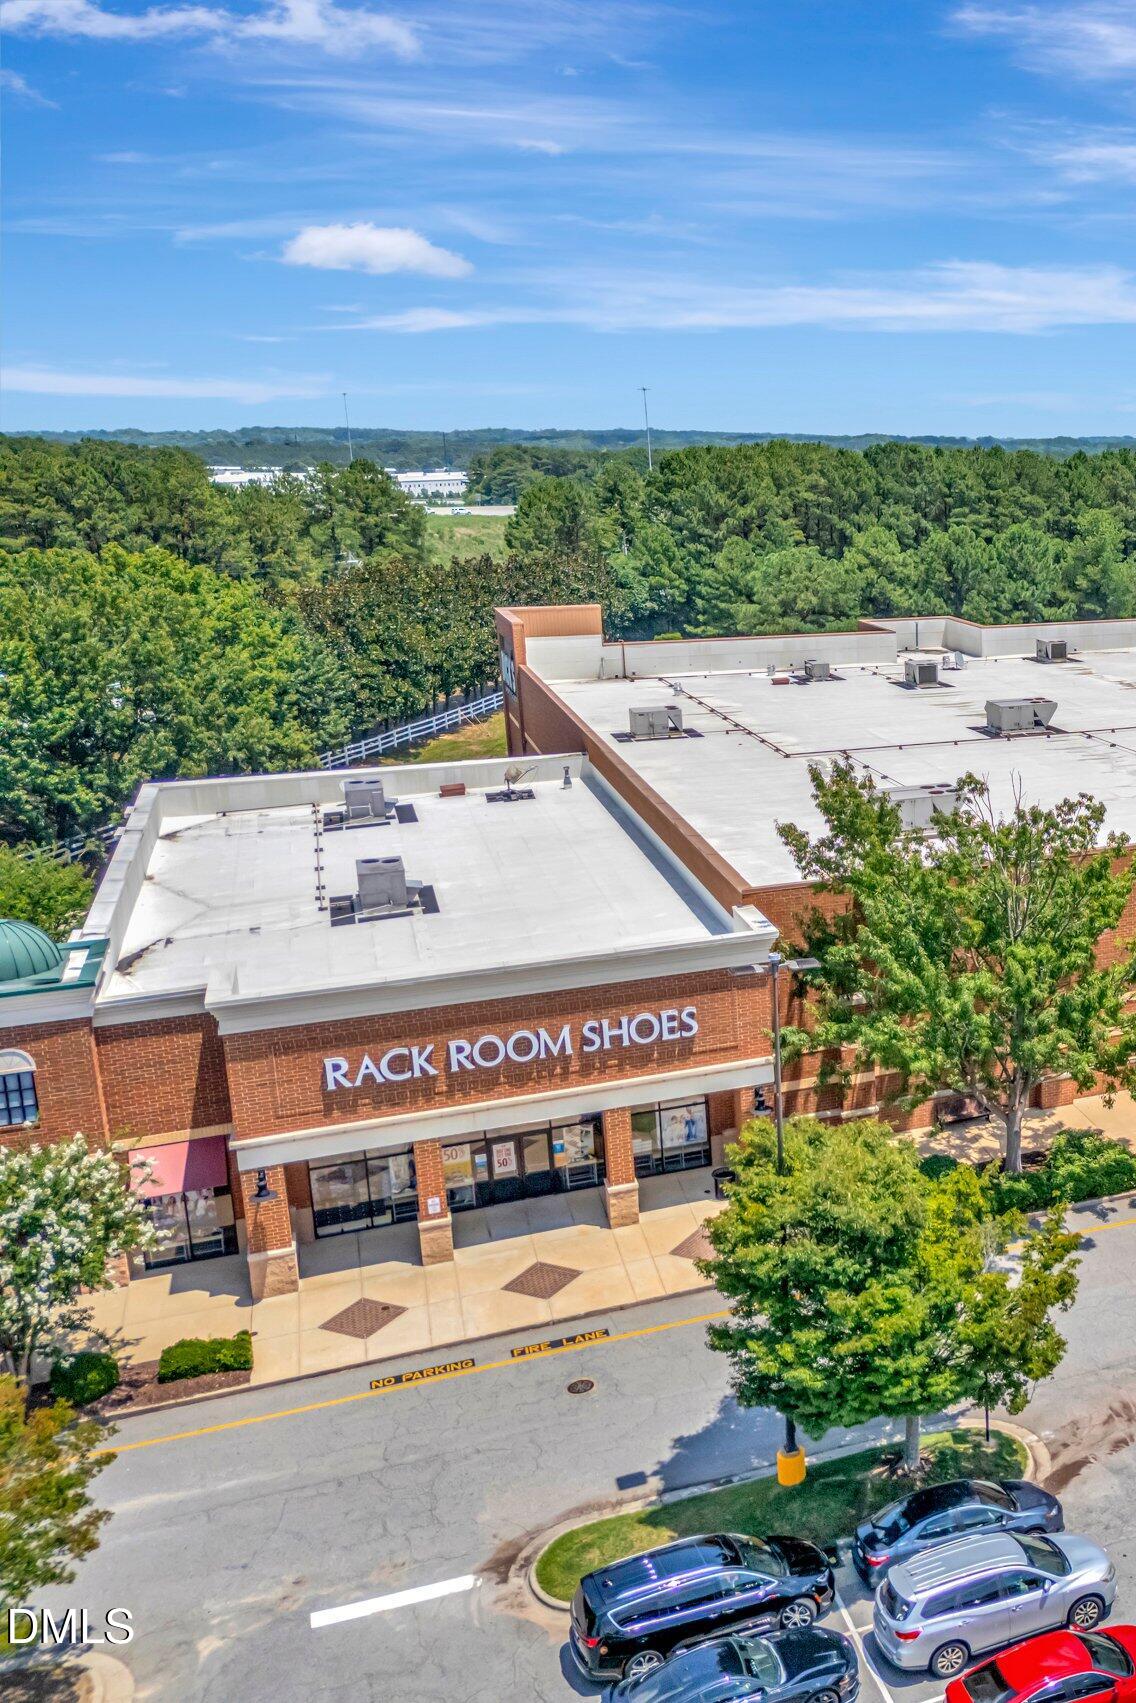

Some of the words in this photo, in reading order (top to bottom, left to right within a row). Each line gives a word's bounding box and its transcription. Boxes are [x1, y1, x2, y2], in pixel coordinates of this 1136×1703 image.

[322, 1044, 439, 1091] RACK
[447, 1025, 573, 1073] ROOM
[581, 1006, 699, 1052] SHOES
[512, 1341, 551, 1357] FIRE
[562, 1330, 608, 1345] LANE
[371, 1377, 395, 1389] NO
[401, 1359, 473, 1382] PARKING
